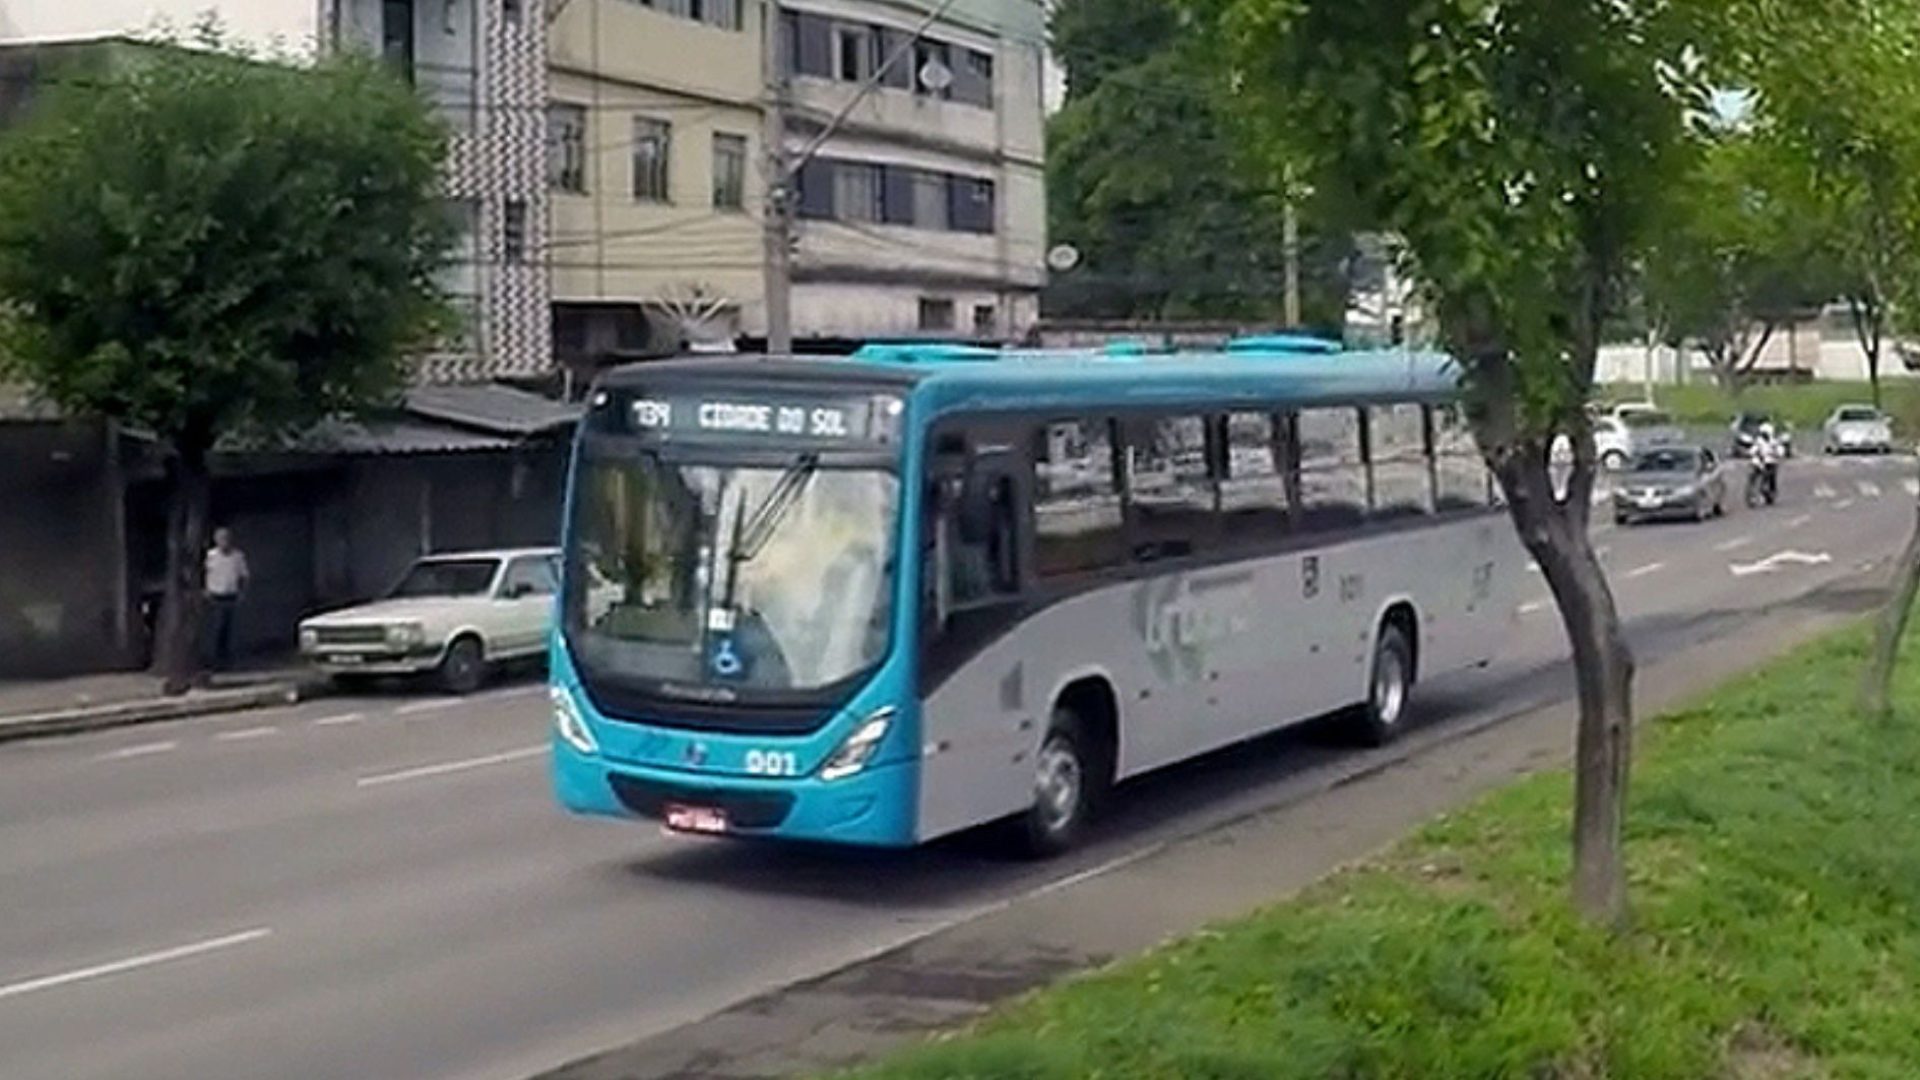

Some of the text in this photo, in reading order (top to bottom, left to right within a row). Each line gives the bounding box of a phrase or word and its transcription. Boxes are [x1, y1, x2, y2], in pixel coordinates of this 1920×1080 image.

[699, 403, 771, 431] CIDADE
[777, 406, 804, 433] DO
[811, 408, 847, 435] SOL
[745, 749, 796, 776] 001
